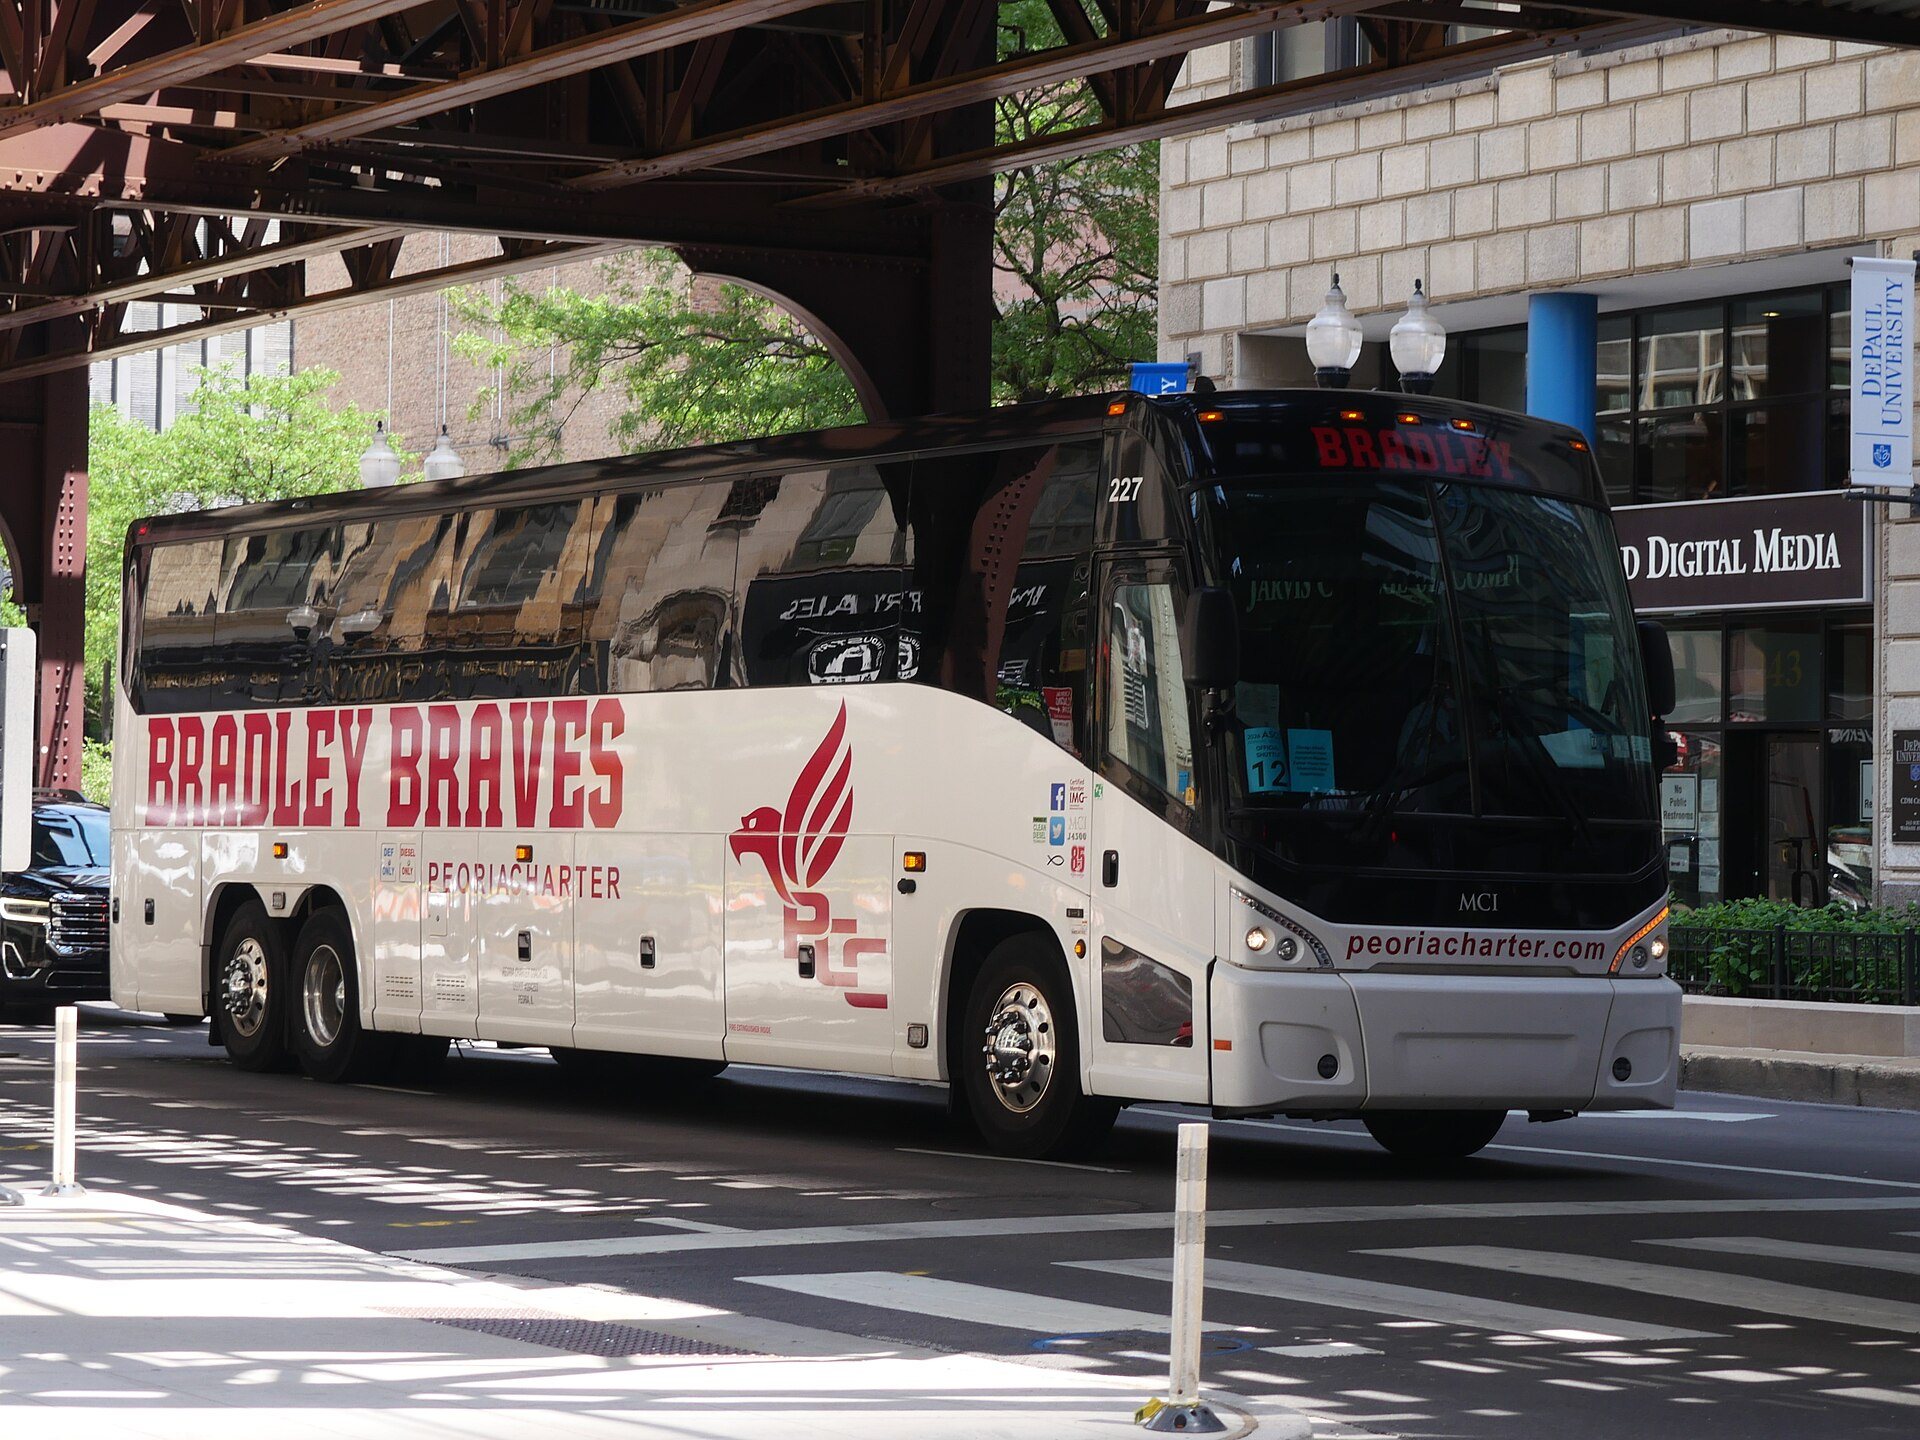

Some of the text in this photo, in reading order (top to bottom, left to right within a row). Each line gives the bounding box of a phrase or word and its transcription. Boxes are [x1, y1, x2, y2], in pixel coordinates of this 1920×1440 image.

[1862, 303, 1882, 398] DEPAUL
[1882, 277, 1903, 427] UNIVERSITY
[1311, 427, 1514, 480] BRADLEY
[1109, 476, 1144, 502] 227
[1646, 536, 1747, 579] DIGITAL
[1753, 528, 1841, 573] MEDIA
[145, 698, 625, 828] BRADLEY BRAVES
[1252, 760, 1288, 787] 12
[1669, 797, 1687, 807] Public
[1674, 785, 1682, 793] No
[1663, 810, 1693, 820] Restrooms
[383, 848, 394, 857] DEF
[400, 848, 416, 857] DIESEL
[402, 867, 414, 876] ONLY
[428, 862, 621, 899] PEORIACHARTER
[1458, 893, 1499, 912] MCI
[1346, 931, 1606, 960] peoriacharter.com
